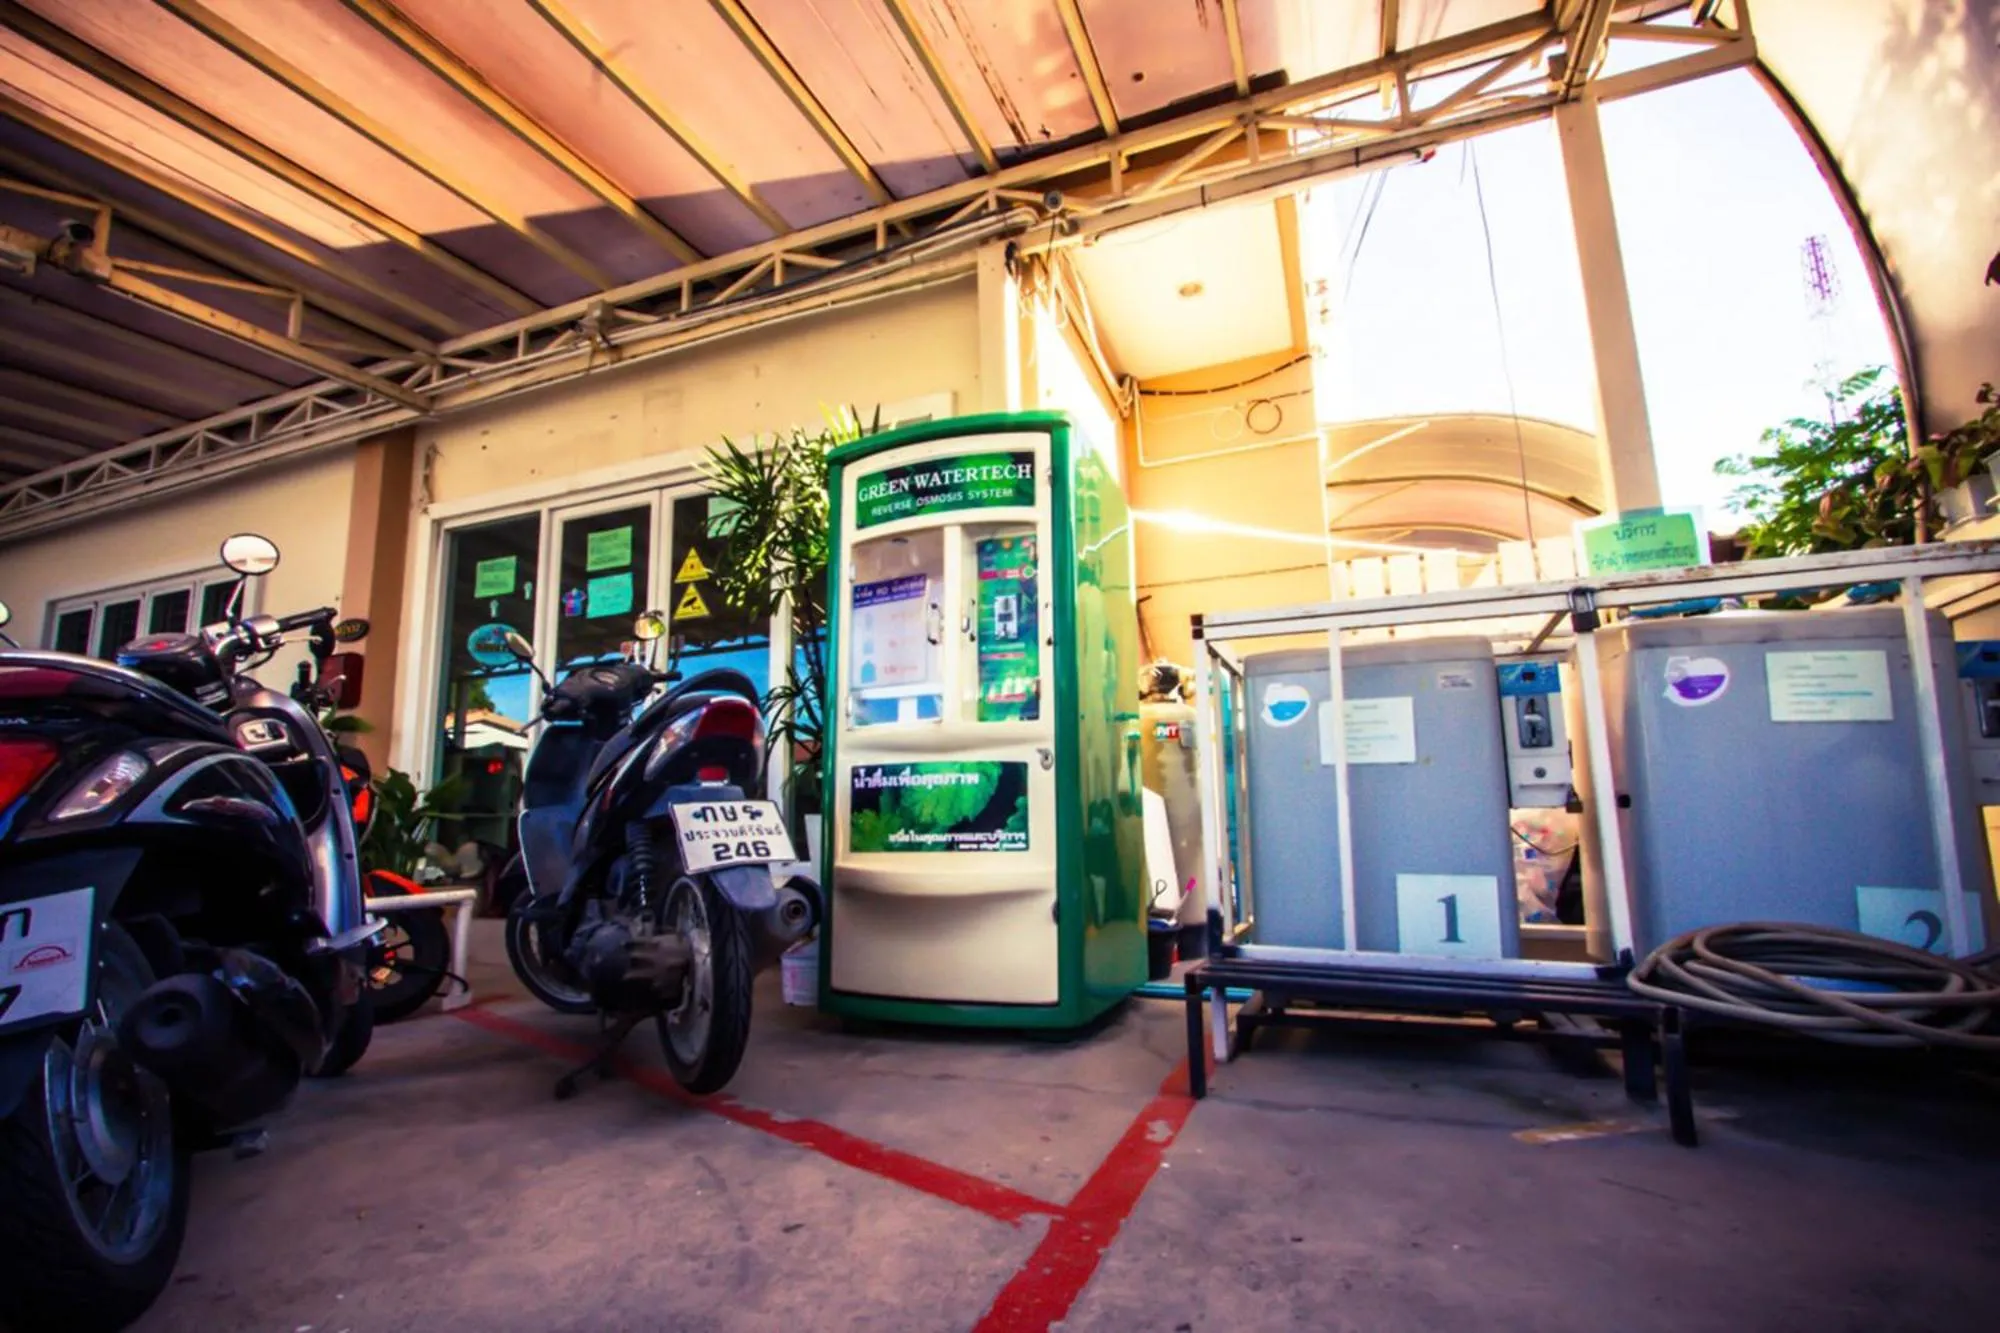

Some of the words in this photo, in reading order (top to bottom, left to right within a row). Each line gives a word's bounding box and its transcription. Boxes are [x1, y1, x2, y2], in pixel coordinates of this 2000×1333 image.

[858, 476, 910, 502] GREEN
[913, 464, 1032, 489] WATERTECH
[871, 499, 912, 517] REVERSE
[916, 491, 964, 507] OSMOSIS
[967, 487, 1014, 500] SYSTEM
[712, 841, 771, 861] 246
[1436, 893, 1463, 944] 1
